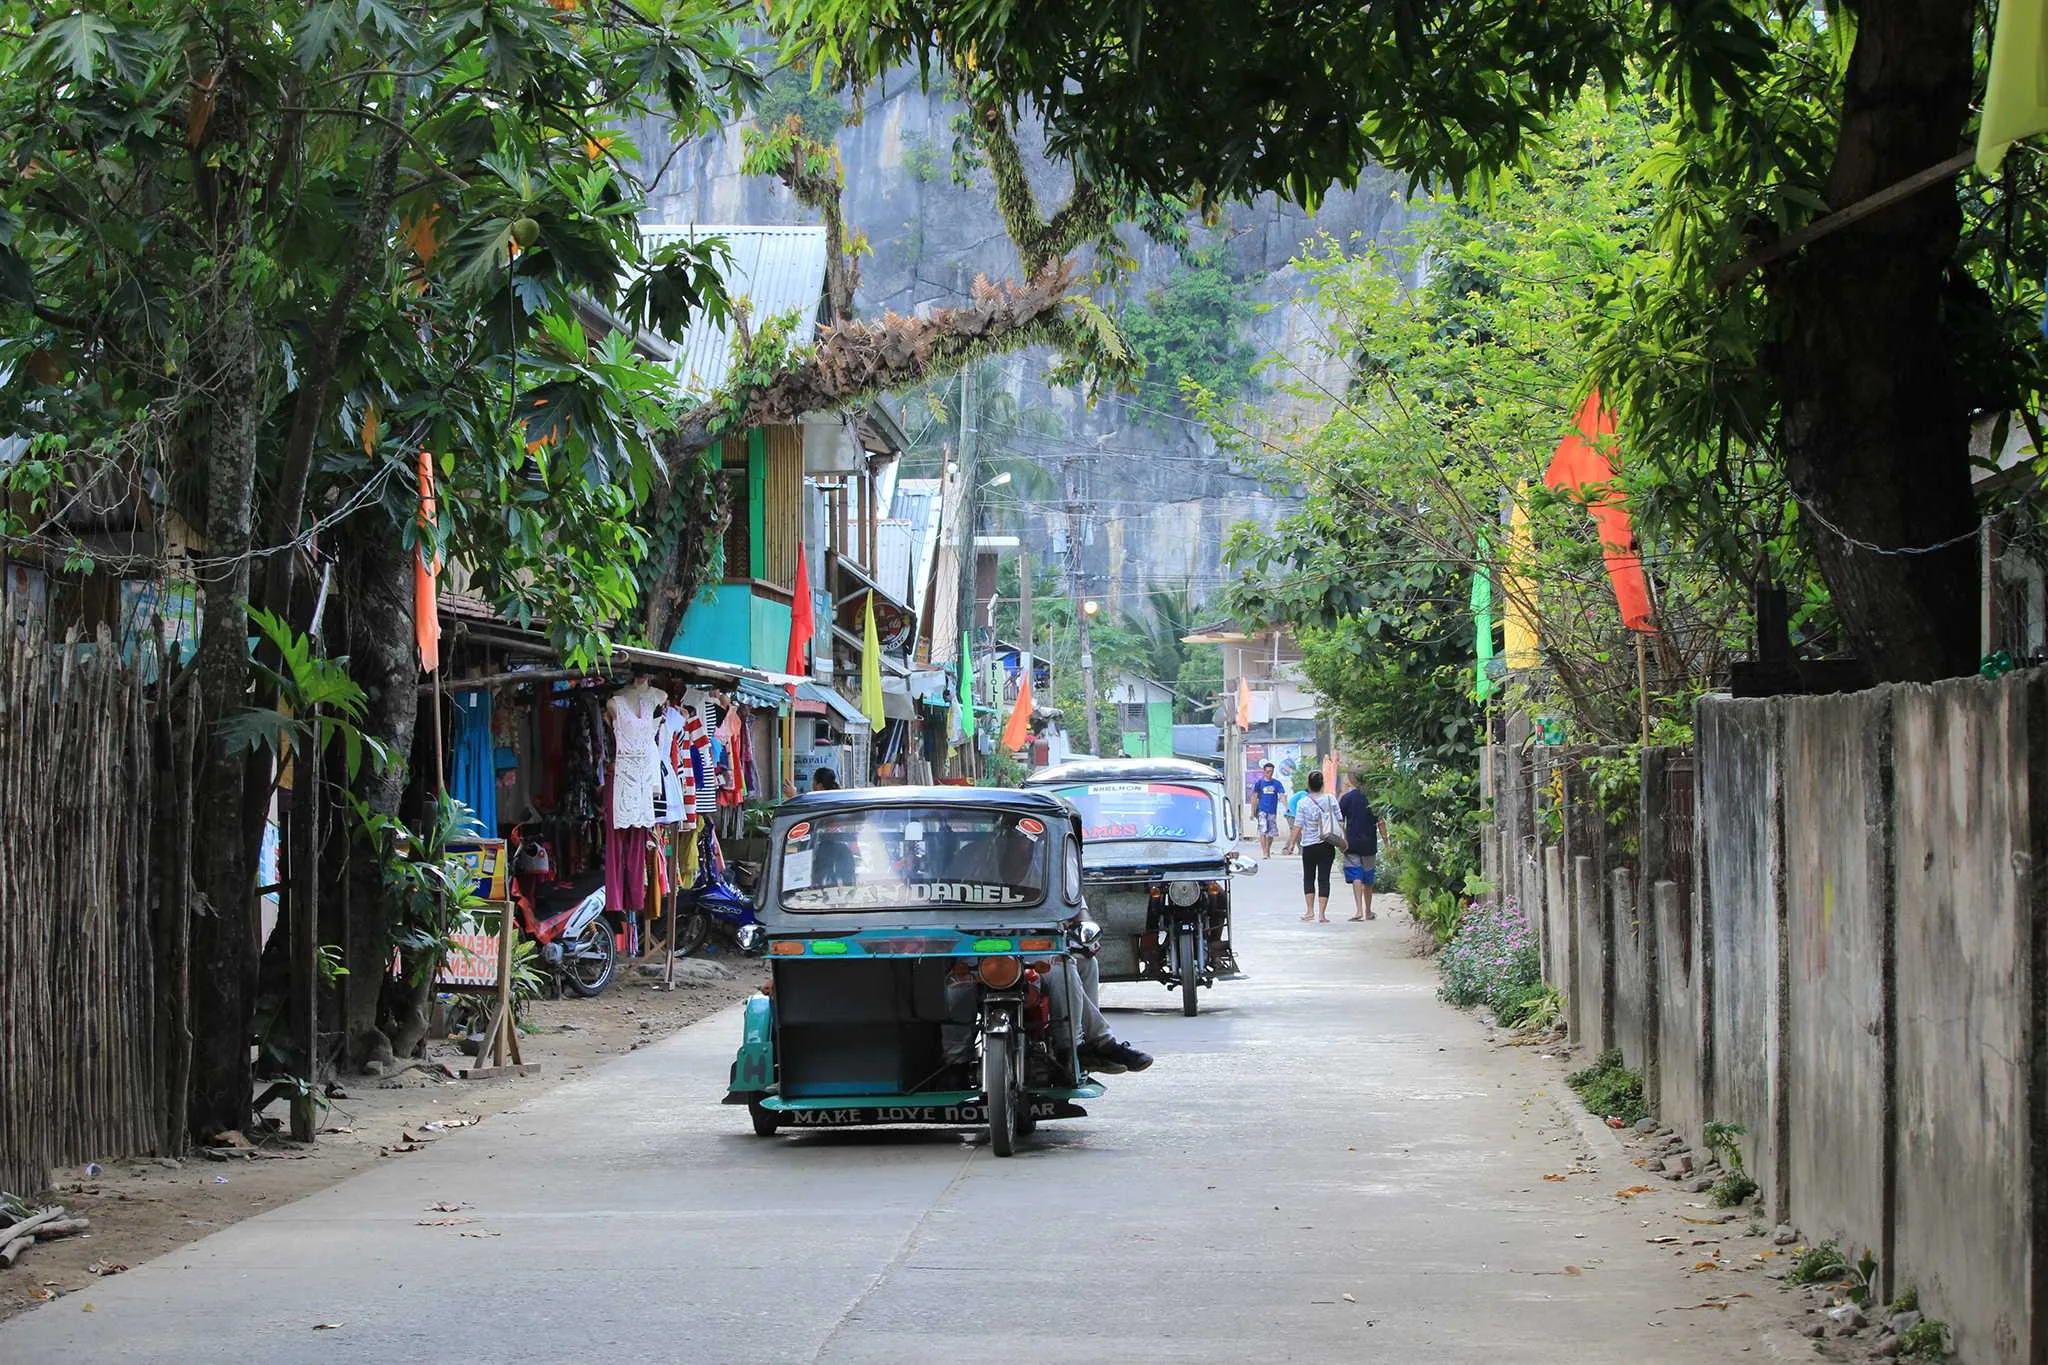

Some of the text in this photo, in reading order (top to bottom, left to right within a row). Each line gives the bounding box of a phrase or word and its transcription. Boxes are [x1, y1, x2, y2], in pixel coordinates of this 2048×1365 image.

[792, 1108, 862, 1124] MAKE
[876, 1107, 936, 1121] LOVE
[1029, 1103, 1056, 1117] AR
